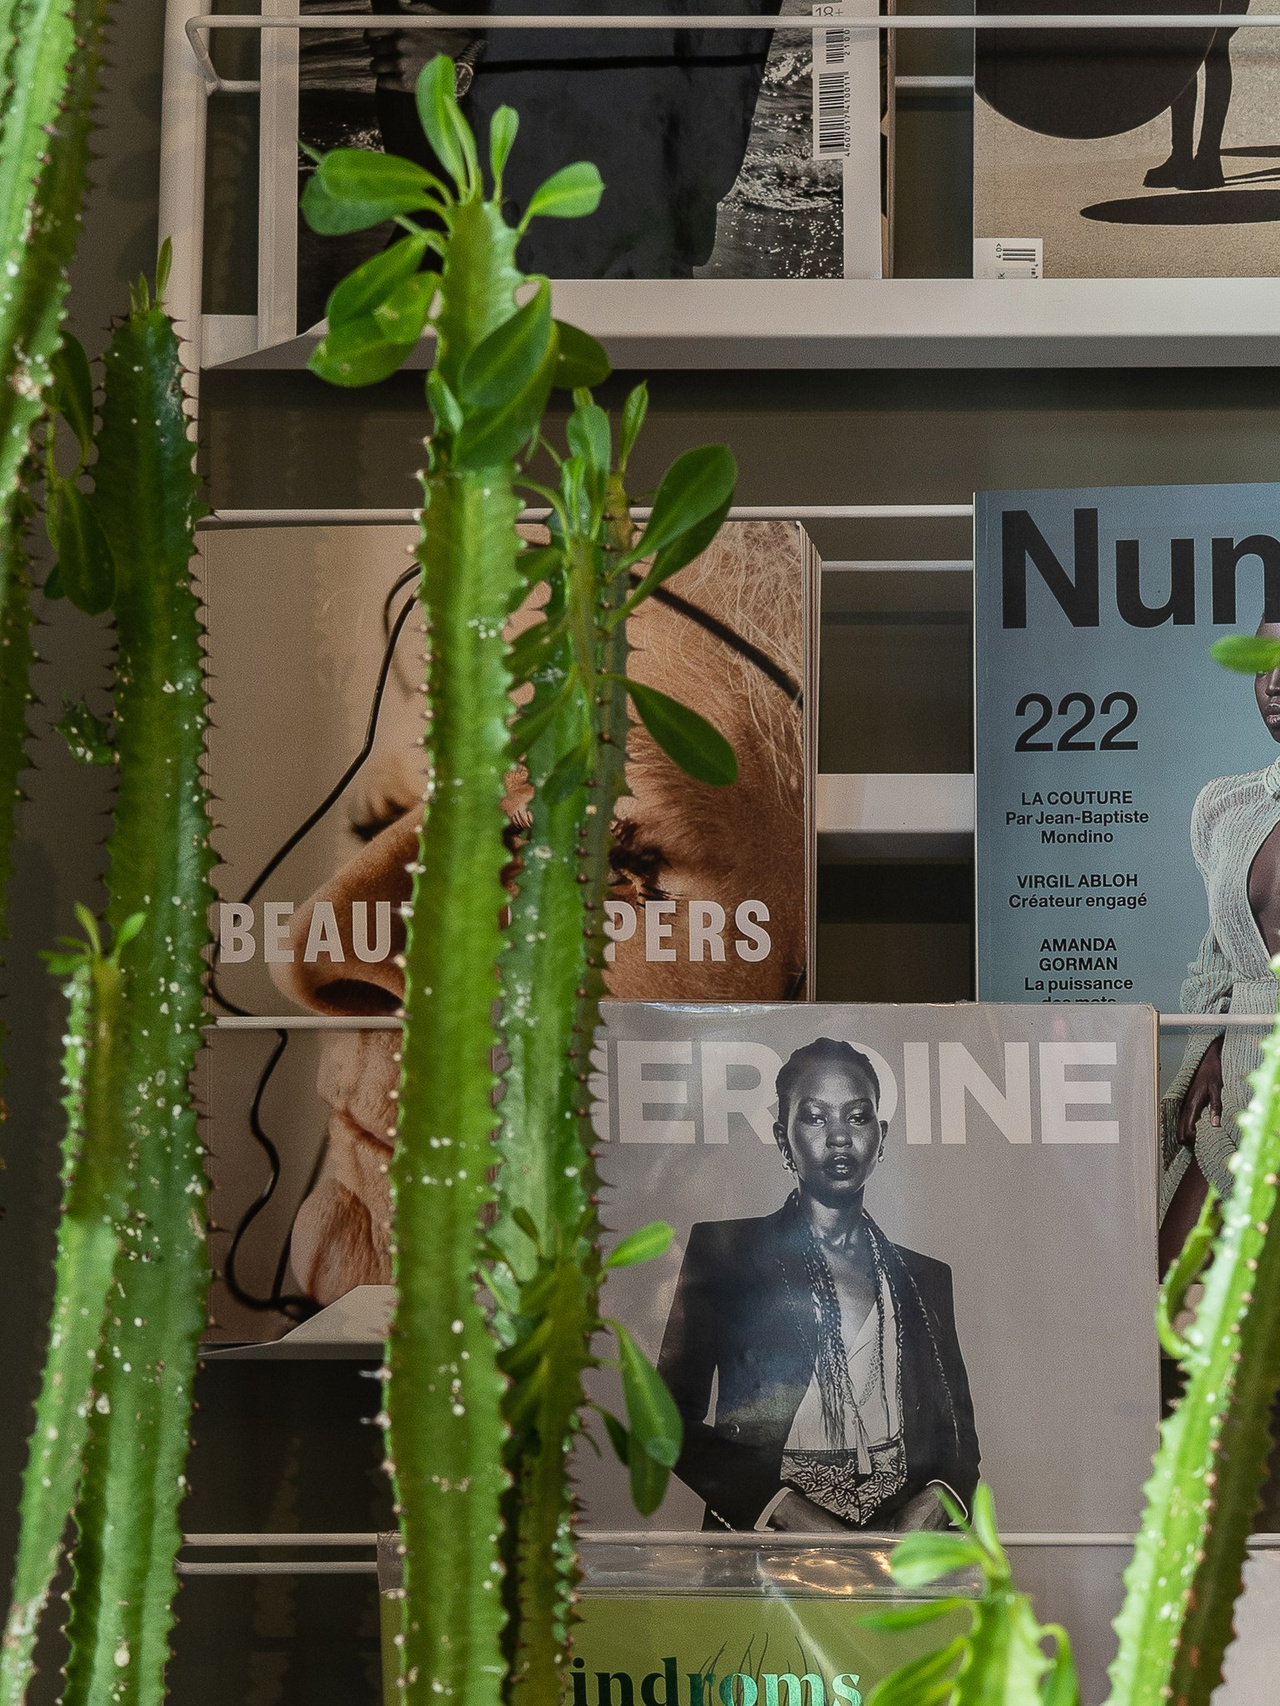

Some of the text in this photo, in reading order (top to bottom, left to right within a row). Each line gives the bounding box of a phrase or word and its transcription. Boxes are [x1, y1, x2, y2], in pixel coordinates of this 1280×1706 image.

[1014, 691, 1139, 752] 222
[1021, 790, 1133, 806] LA COUTURE
[1005, 809, 1149, 828] Par Jean-Baptiste
[1040, 829, 1114, 845] Mondino
[1016, 873, 1139, 889] VIRGIL ABLOH
[1008, 892, 1148, 911] Créateur engagé
[219, 900, 772, 964] BEAU PERS
[1039, 937, 1117, 953] AMANDA
[1038, 957, 1119, 972] GORMAN
[1024, 977, 1133, 993] La puissance
[604, 1040, 1120, 1145] ERINE
